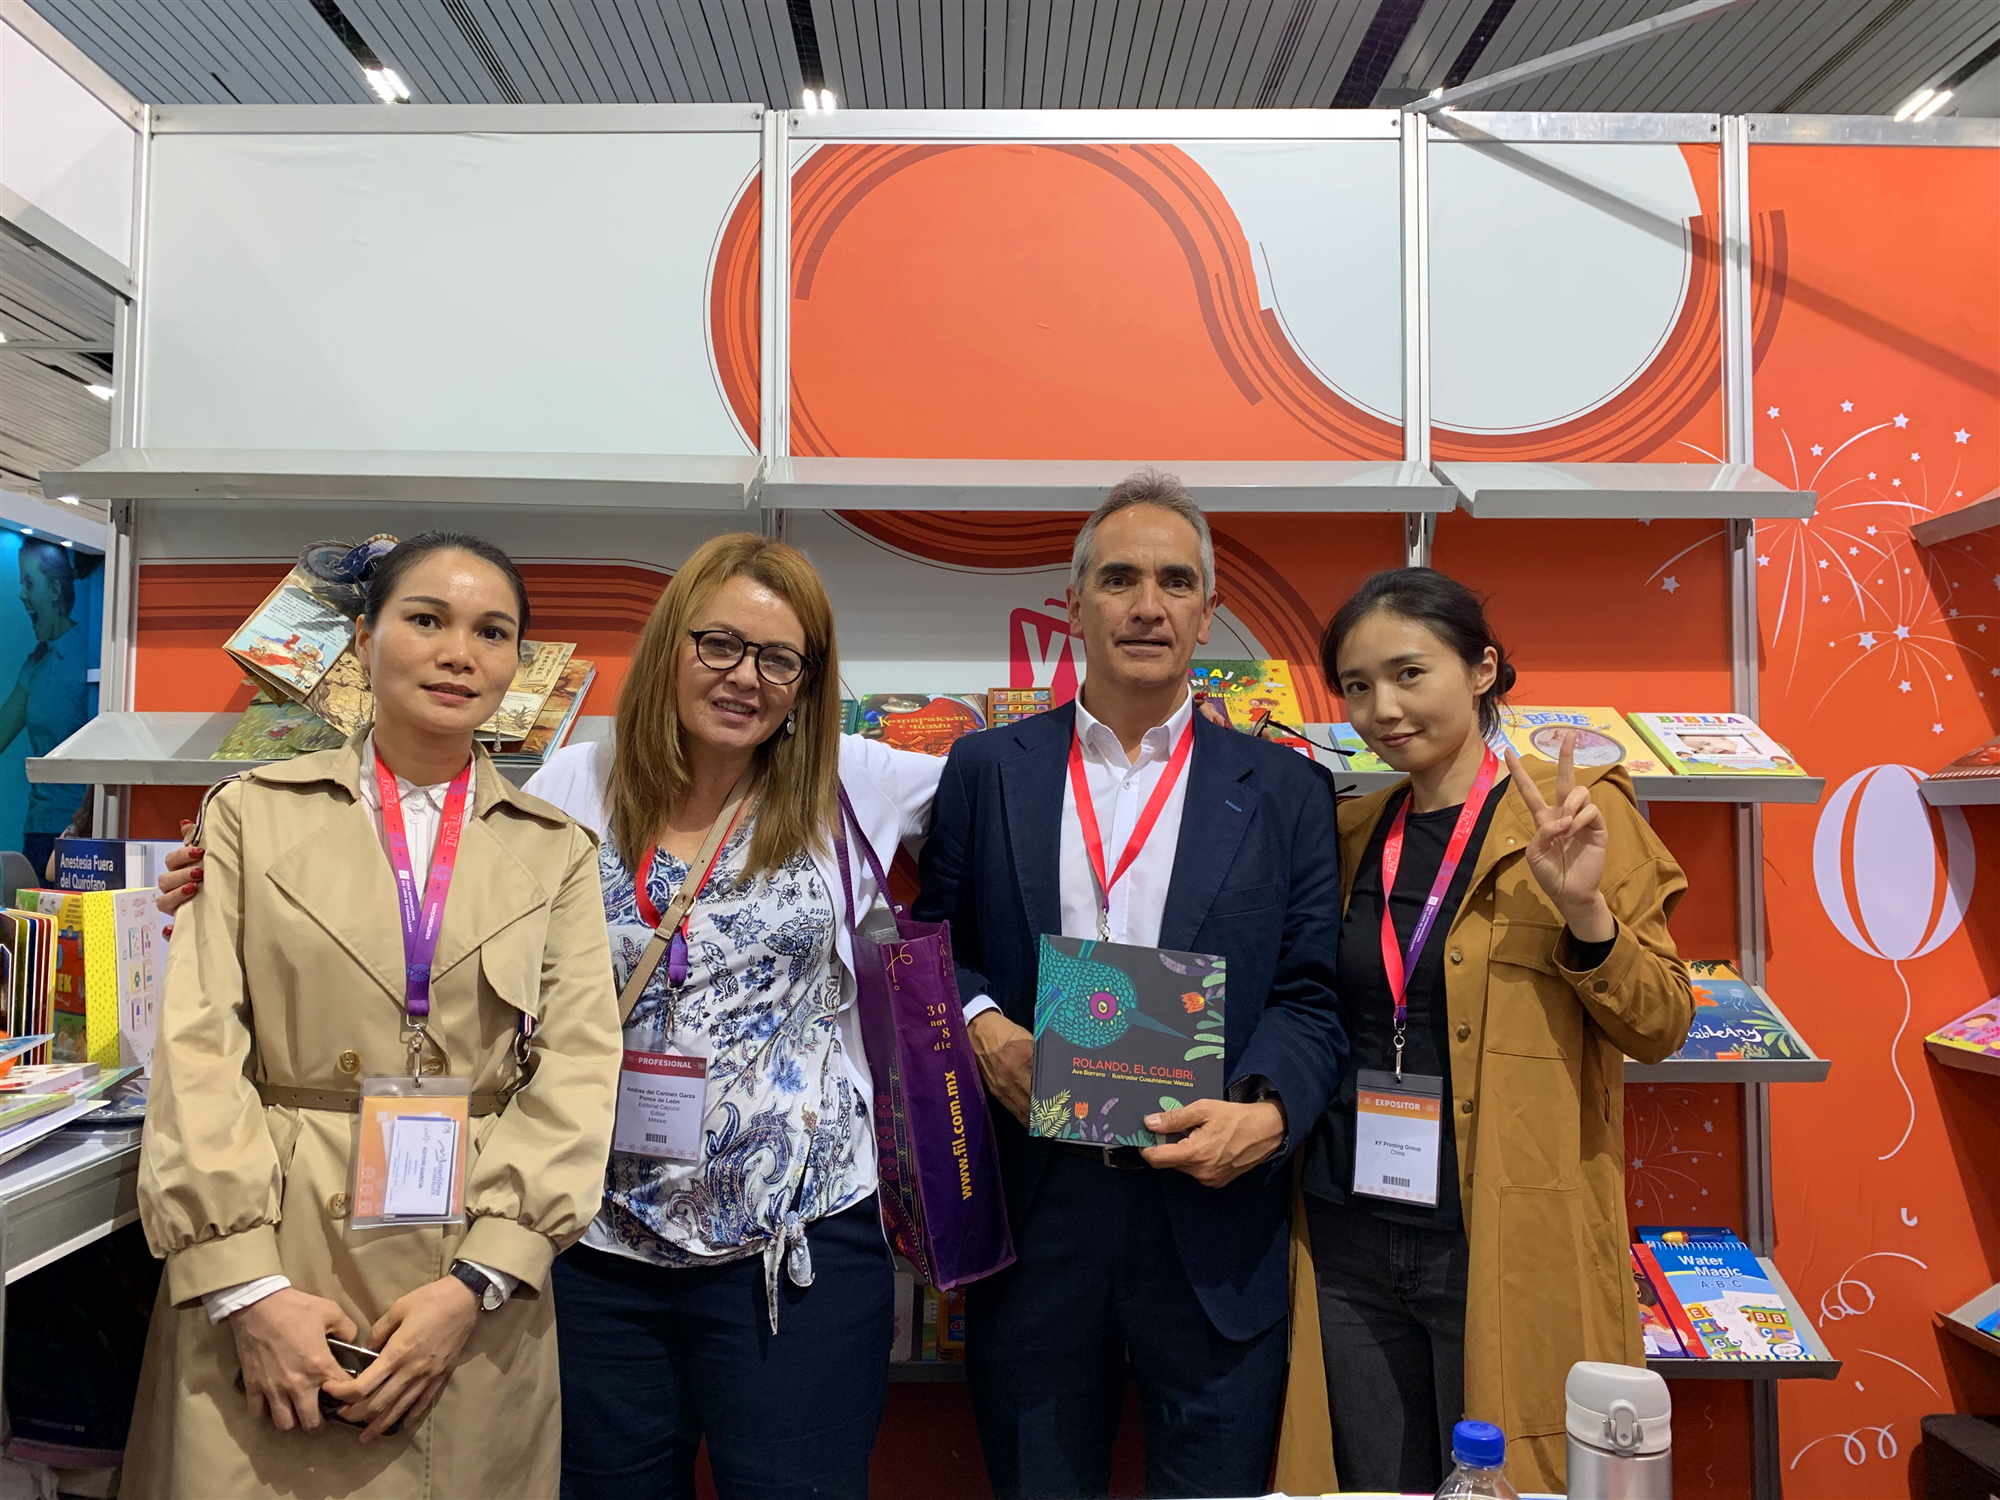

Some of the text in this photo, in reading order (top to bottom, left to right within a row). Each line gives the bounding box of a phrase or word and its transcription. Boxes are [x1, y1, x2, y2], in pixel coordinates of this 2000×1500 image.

[1656, 716, 1745, 724] BIBLIA
[60, 853, 113, 872] Anestesia Fuera
[60, 874, 106, 891] del Quirófano
[927, 1002, 946, 1016] 30
[930, 1018, 947, 1027] nov
[942, 1028, 950, 1038] 8
[638, 1057, 692, 1069] PROFESIONAL
[1072, 1057, 1131, 1074] ROLANDO,
[1134, 1064, 1147, 1074] EL
[1375, 1099, 1420, 1110] EXPOSITOR
[944, 1070, 972, 1200] www.fil.com.mx
[1383, 1141, 1404, 1150] Printing
[1677, 1255, 1724, 1266] Water
[1694, 1266, 1742, 1278] Magic
